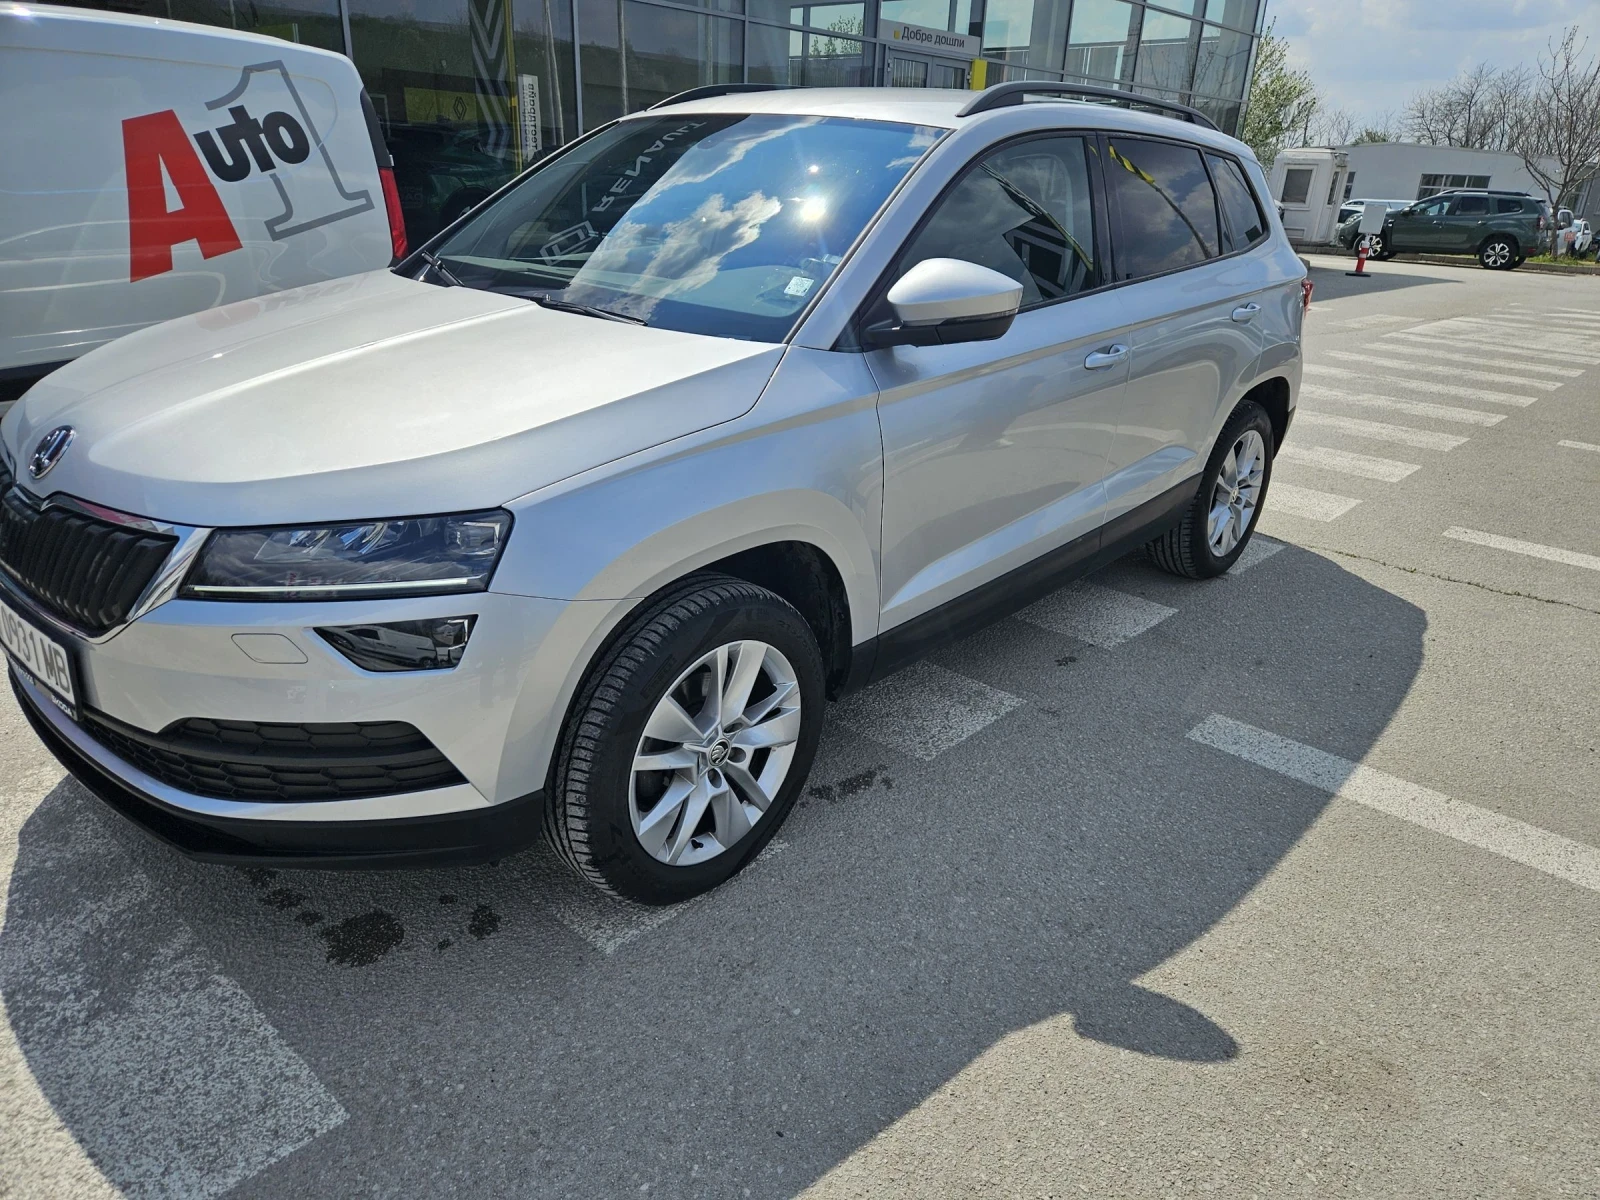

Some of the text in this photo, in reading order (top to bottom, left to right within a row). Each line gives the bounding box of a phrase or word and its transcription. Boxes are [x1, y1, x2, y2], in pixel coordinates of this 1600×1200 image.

[902, 26, 965, 48] Добре дошли
[122, 105, 311, 283] Auto
